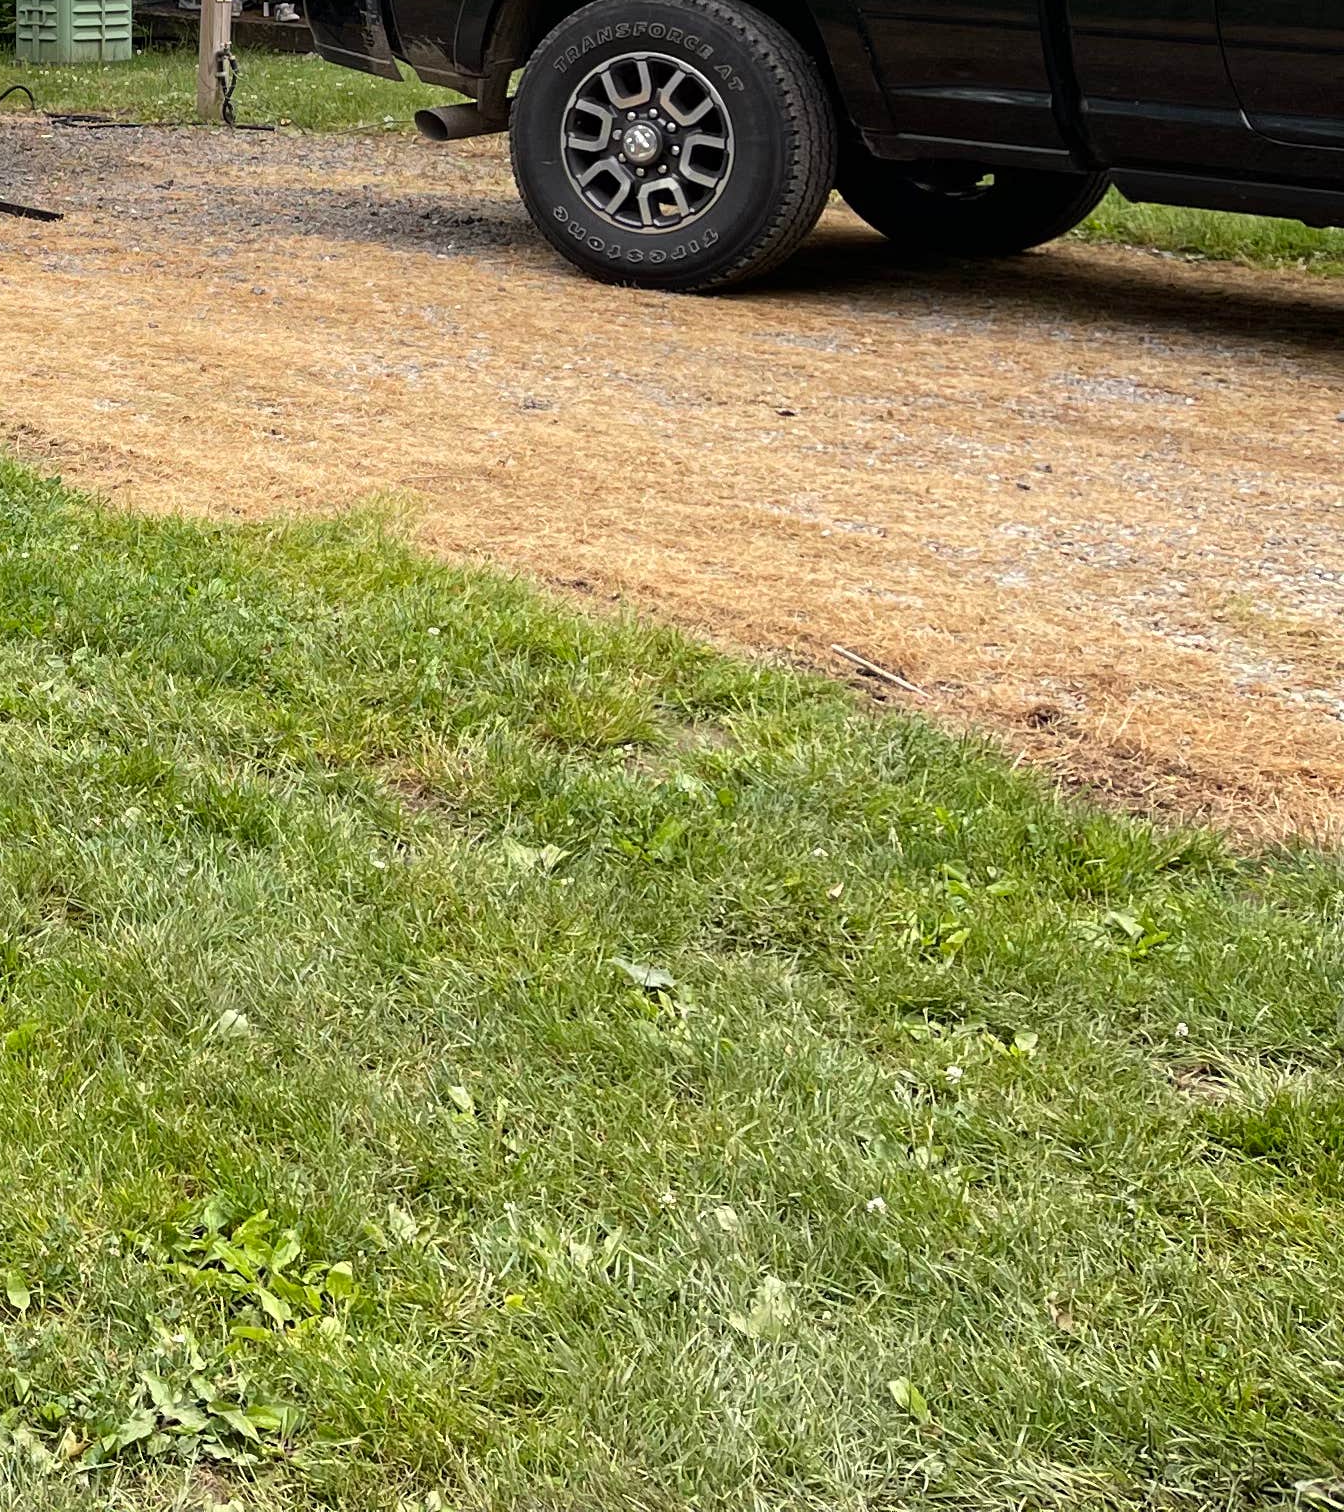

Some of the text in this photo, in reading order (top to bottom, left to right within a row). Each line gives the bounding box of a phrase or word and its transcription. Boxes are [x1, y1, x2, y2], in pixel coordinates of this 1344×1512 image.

[553, 21, 745, 92] TRANSFORCE AT
[553, 205, 719, 264] Firestone
